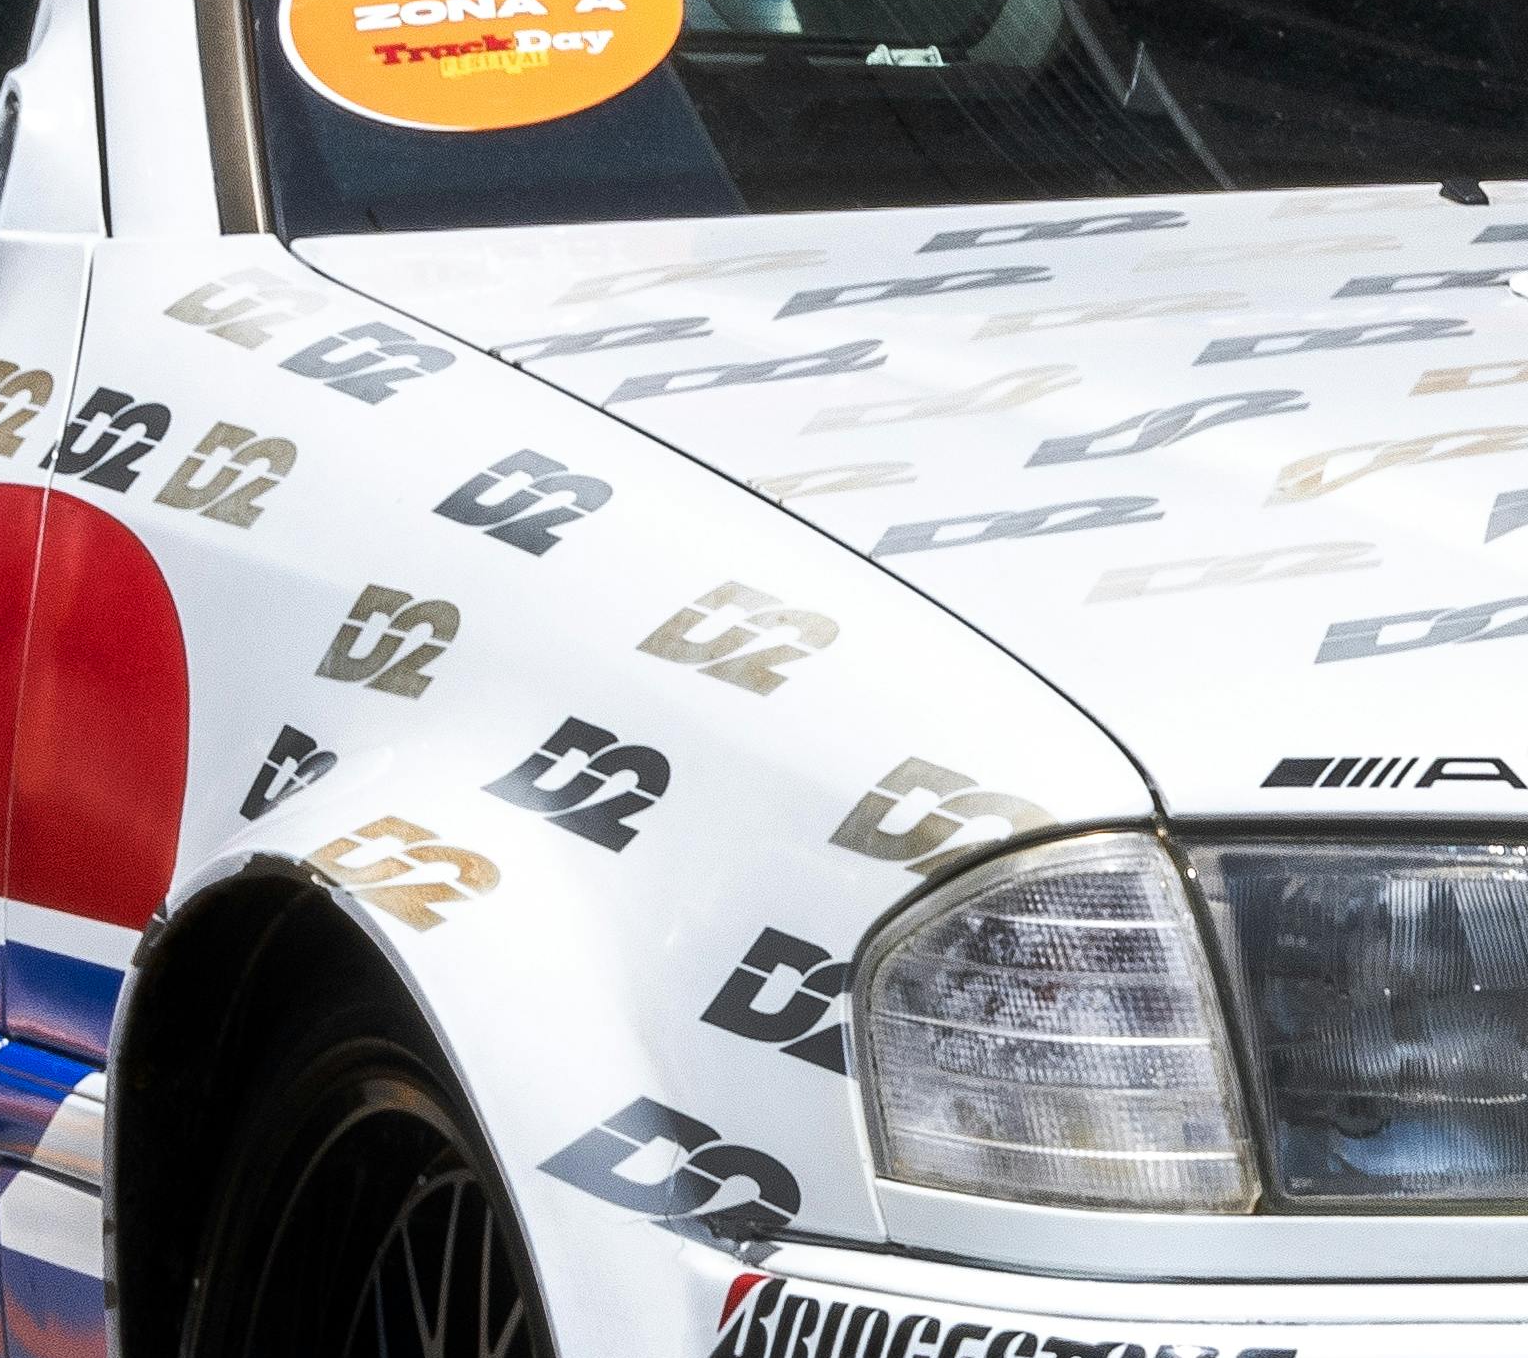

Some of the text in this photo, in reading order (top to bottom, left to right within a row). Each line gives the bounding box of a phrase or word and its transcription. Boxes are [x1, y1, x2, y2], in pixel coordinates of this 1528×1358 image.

[914, 210, 1189, 255] D2
[163, 267, 329, 350] D2
[772, 264, 1055, 321] D2
[278, 321, 458, 406] D2
[603, 338, 888, 410] D2
[1192, 316, 1474, 367] D2
[39, 386, 172, 493] D2
[153, 421, 298, 531] D2
[1023, 387, 1312, 469] D2
[432, 448, 614, 557] D2
[870, 494, 1166, 560] D2
[314, 584, 462, 700] D2
[635, 580, 841, 697] D2
[480, 715, 672, 854] D2
[302, 815, 501, 933] D2
[535, 1095, 802, 1268] D2
